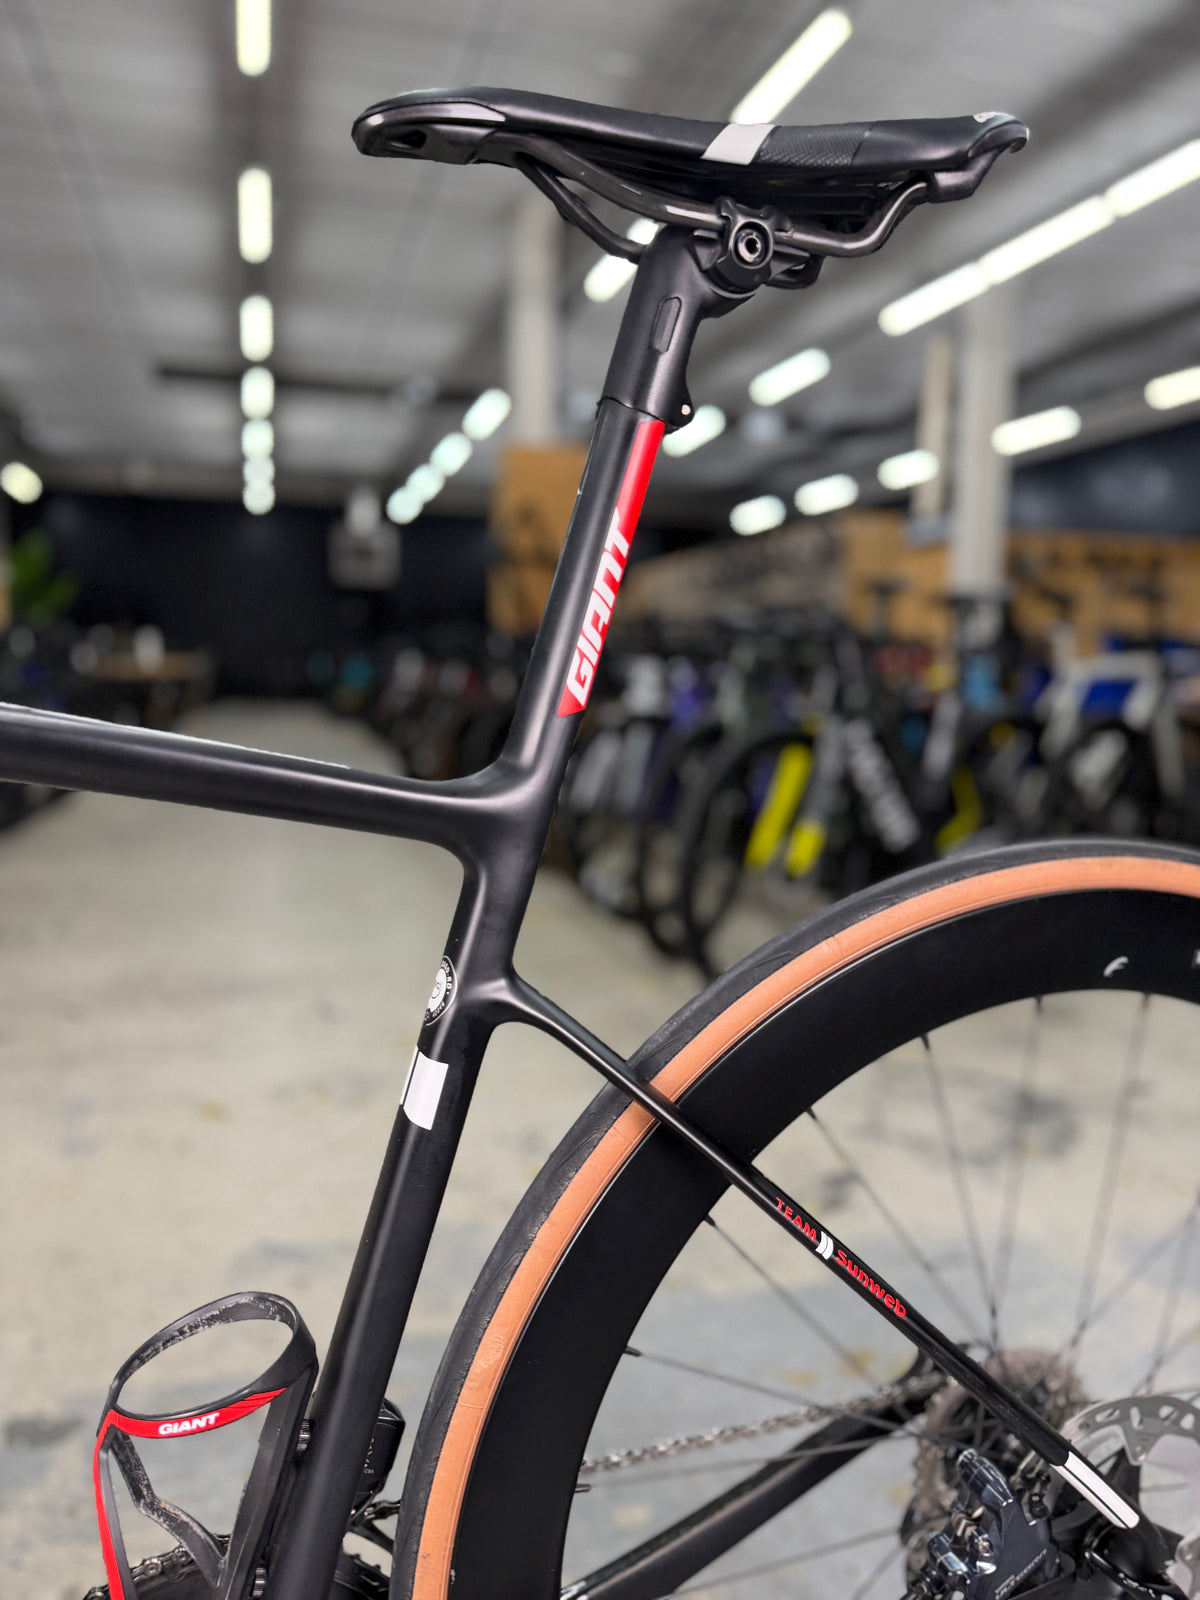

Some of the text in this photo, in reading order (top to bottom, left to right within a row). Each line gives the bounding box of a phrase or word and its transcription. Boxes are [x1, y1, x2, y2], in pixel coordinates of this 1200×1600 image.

[566, 507, 629, 706] GIANT
[776, 1197, 907, 1318] TEAM Sunweb
[158, 1412, 220, 1435] GIANT
